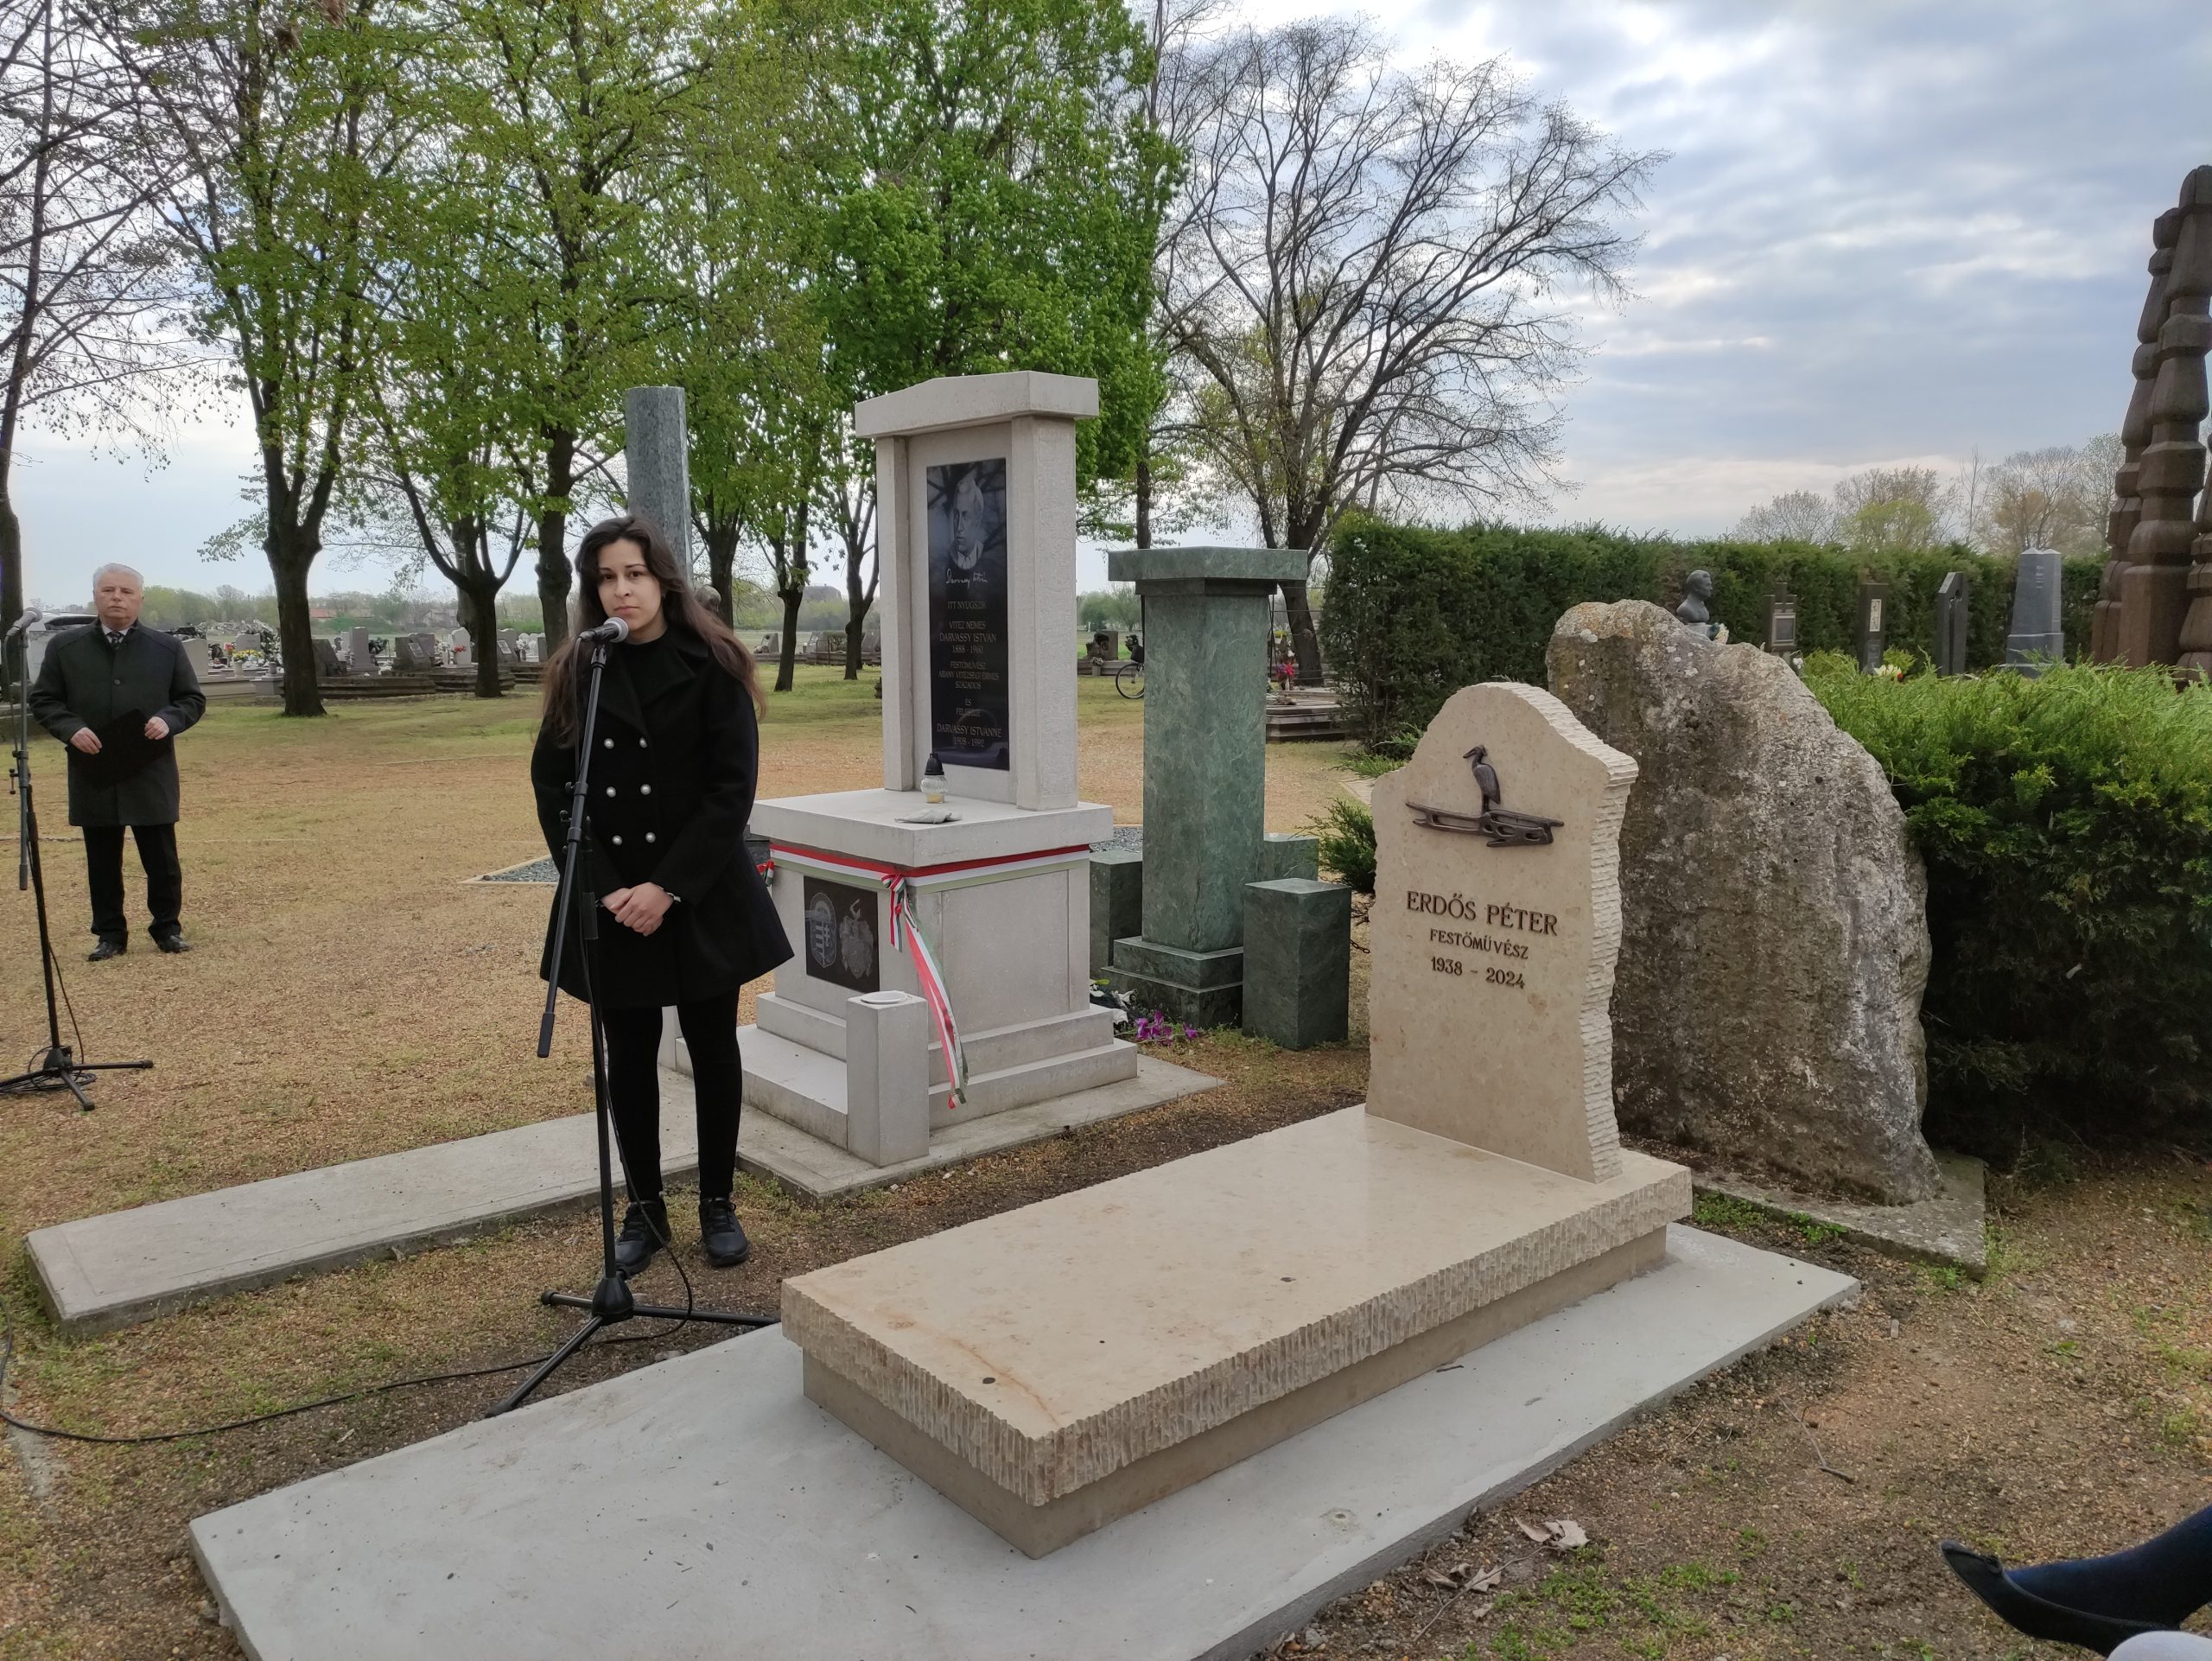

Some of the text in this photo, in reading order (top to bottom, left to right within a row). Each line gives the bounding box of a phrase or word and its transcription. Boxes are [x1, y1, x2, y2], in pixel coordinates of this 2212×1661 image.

[939, 632, 972, 642] DARVASSY
[937, 722, 969, 735] DARVASSY
[1407, 891, 1558, 936] ERDŐS PÉTER
[1429, 928, 1529, 959] FESTŐMŰVÉSZ
[1431, 956, 1463, 977] 1938
[1485, 966, 1525, 990] 2024
